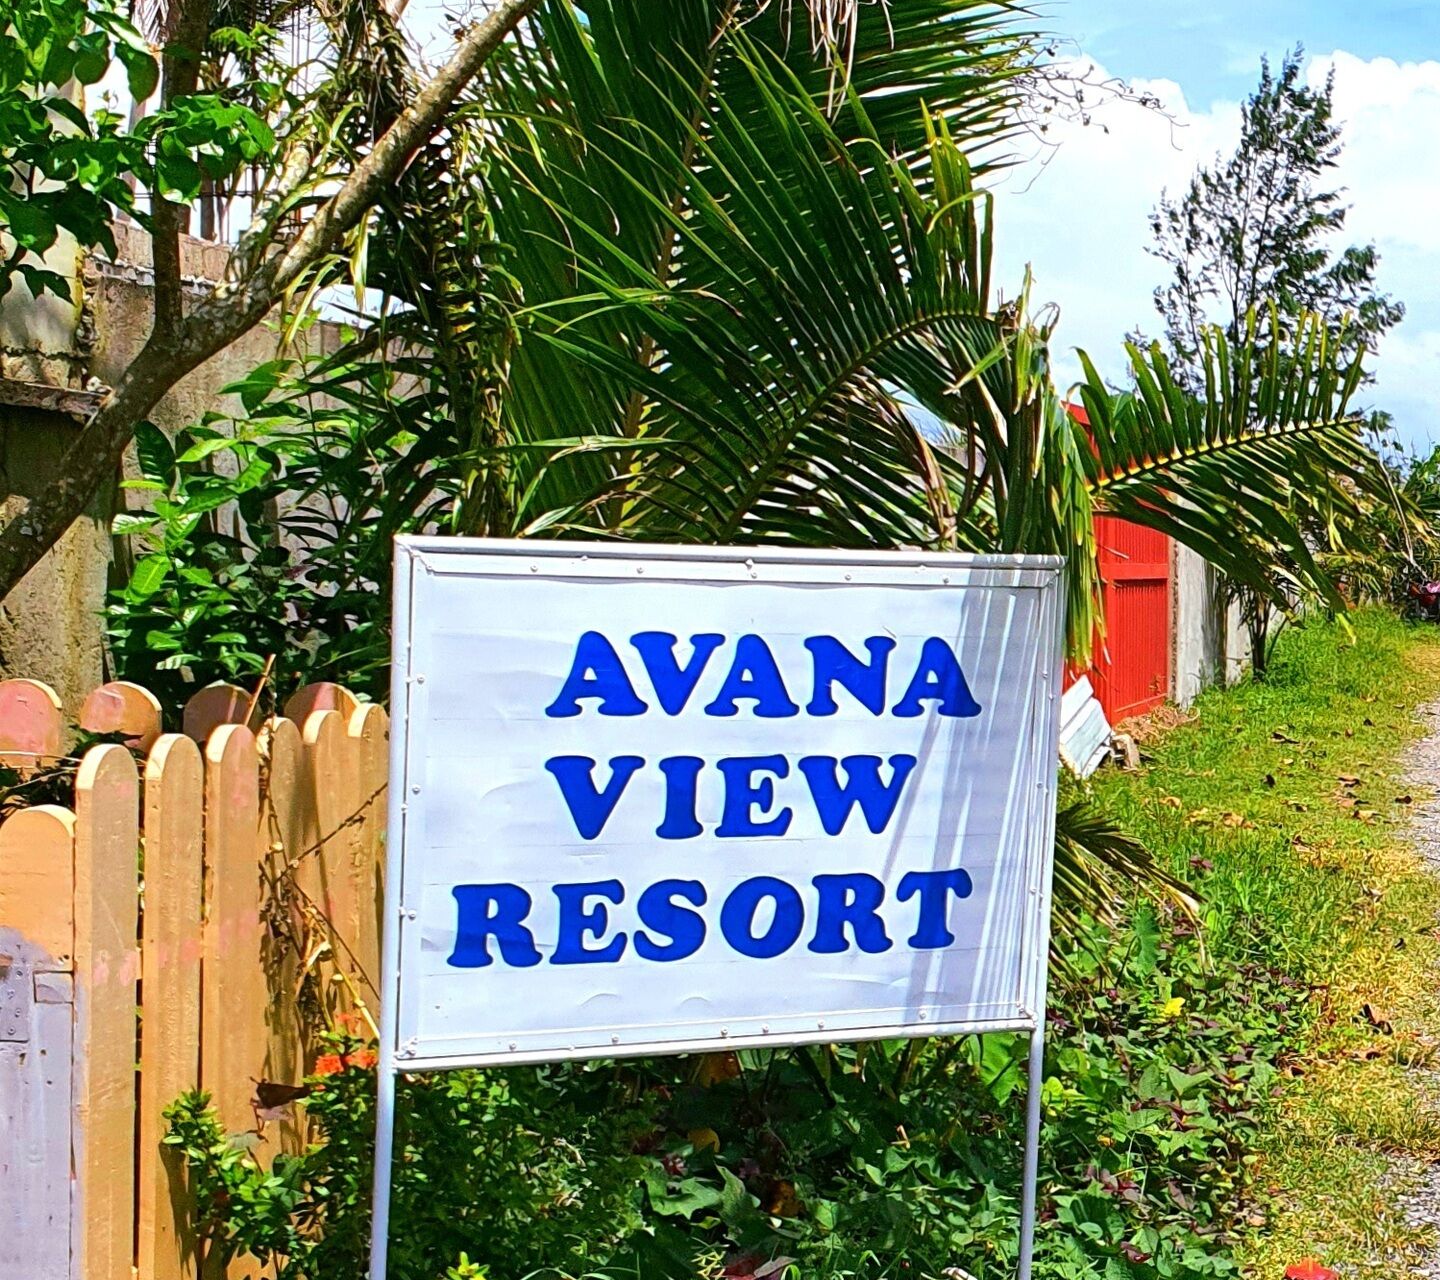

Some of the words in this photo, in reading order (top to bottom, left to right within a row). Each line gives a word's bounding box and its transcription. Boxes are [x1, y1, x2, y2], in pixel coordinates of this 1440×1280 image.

[545, 630, 982, 718] AVANA
[544, 753, 918, 841] VIEW
[446, 868, 973, 968] RESORT
